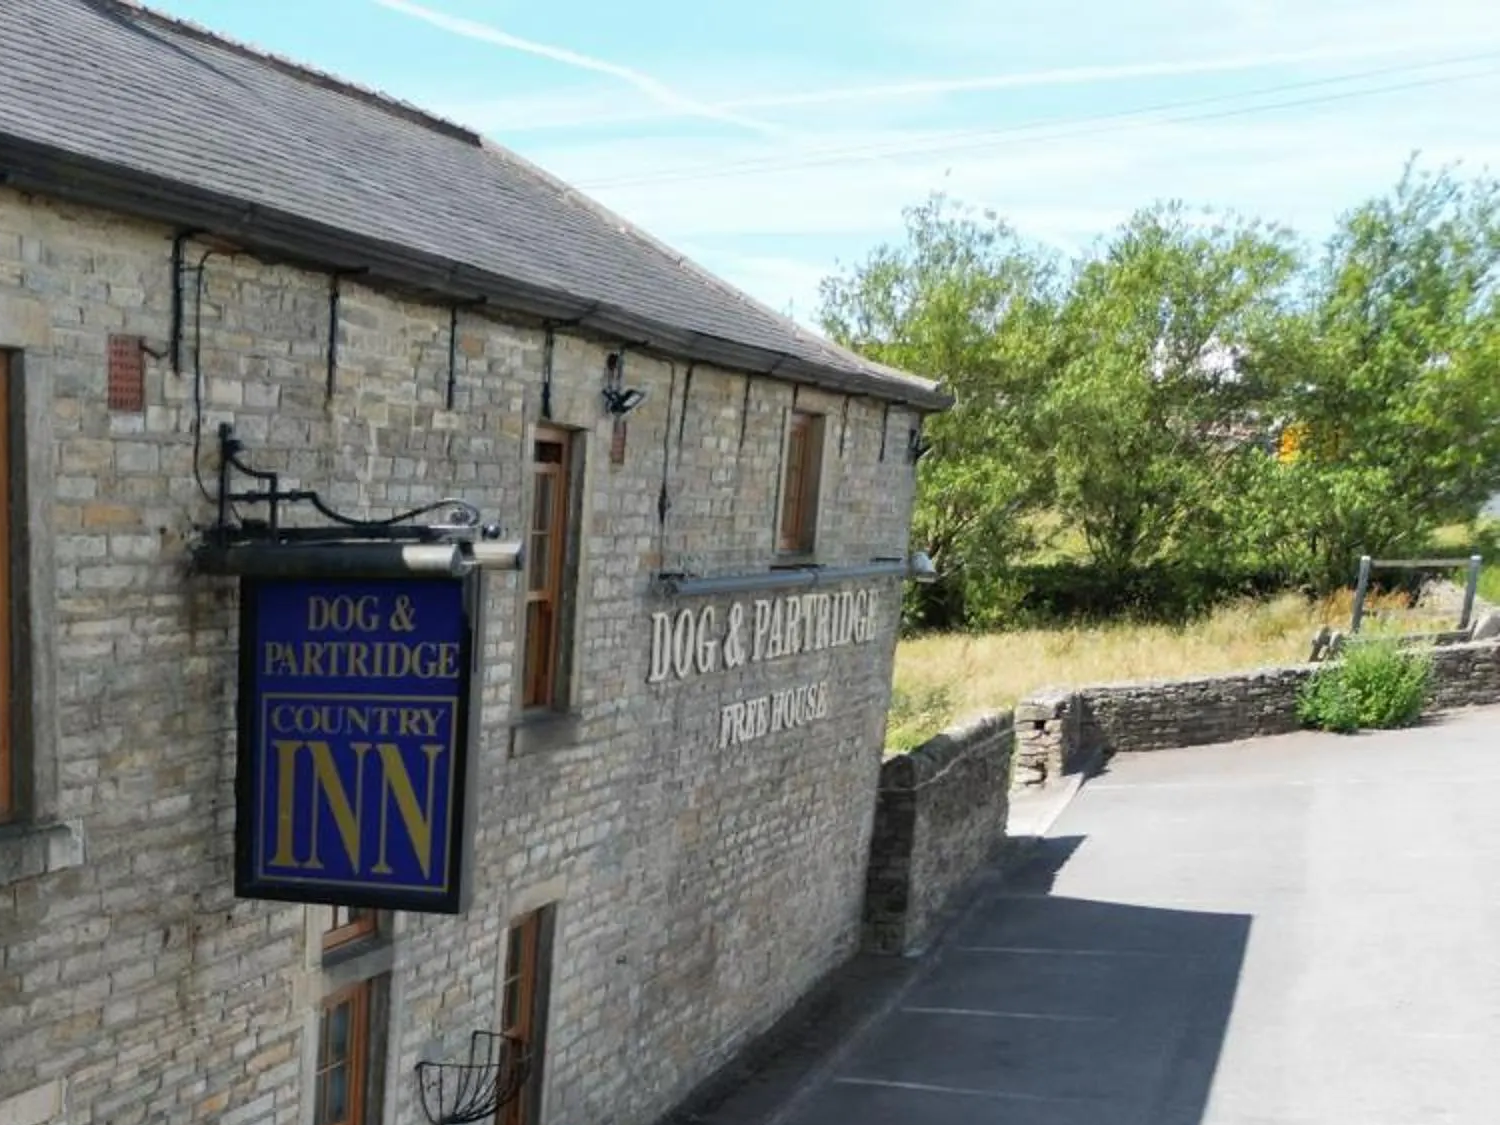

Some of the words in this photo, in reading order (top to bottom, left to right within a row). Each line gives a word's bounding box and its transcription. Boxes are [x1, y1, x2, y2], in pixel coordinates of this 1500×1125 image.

[307, 595, 380, 633] DOG
[389, 595, 417, 632] &
[647, 605, 717, 683] DOG
[722, 602, 746, 669] &
[751, 589, 880, 661] PARTRIDGE
[263, 641, 460, 679] PARTRIDGE
[271, 705, 445, 737] COUNTRY
[718, 696, 768, 749] FREE
[770, 681, 829, 732] HOUSE
[268, 739, 446, 881] INN
